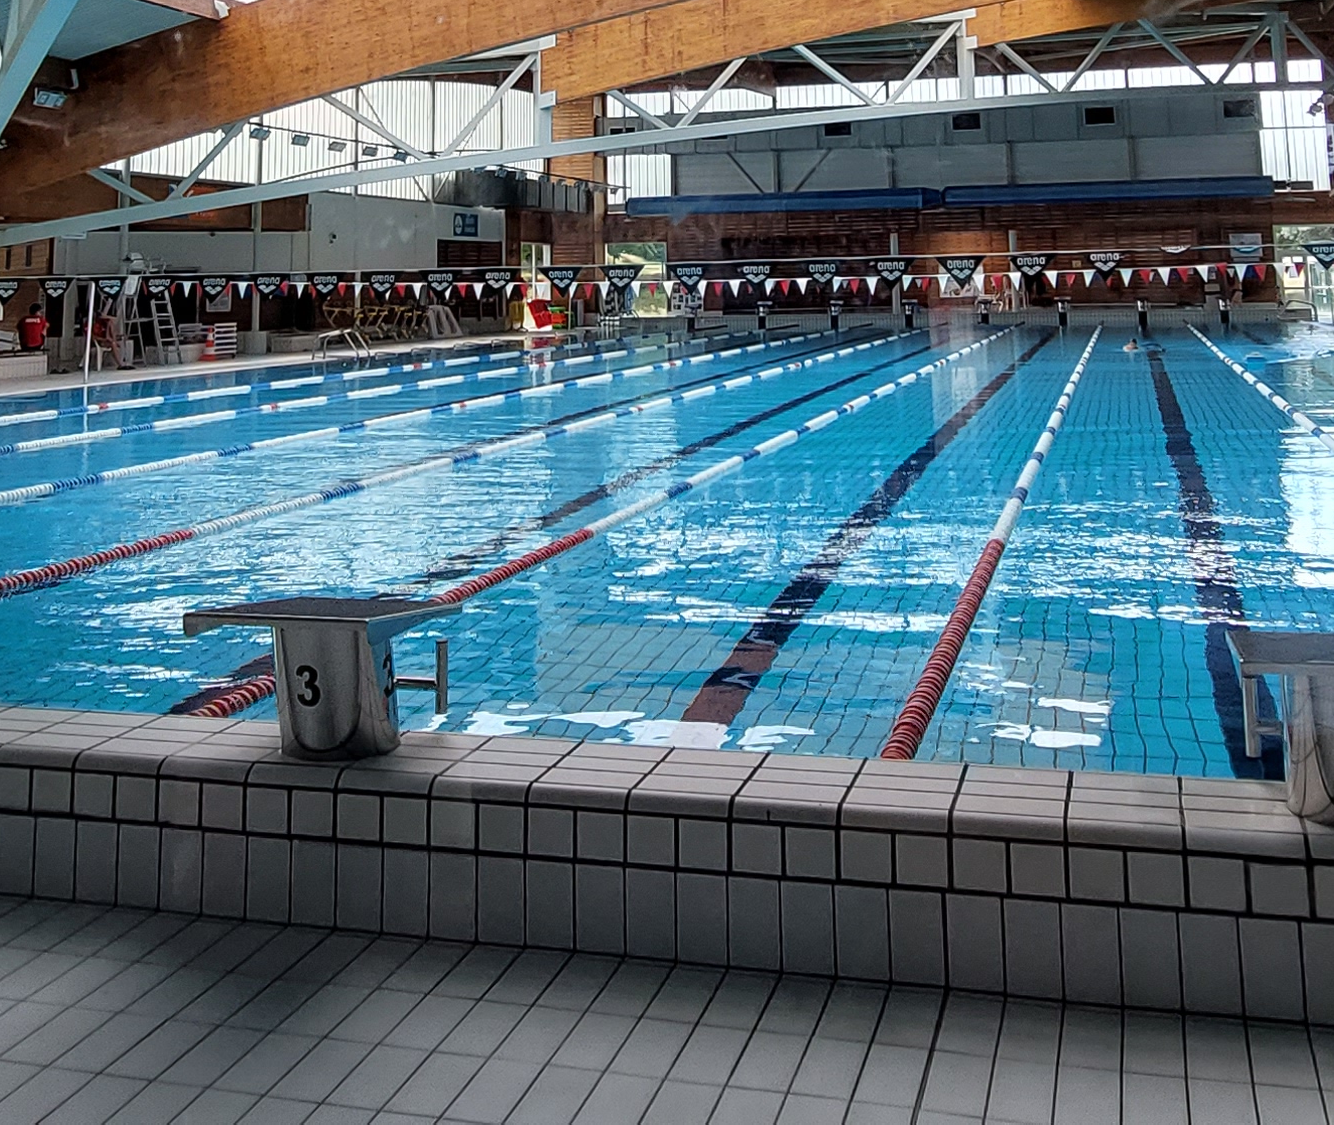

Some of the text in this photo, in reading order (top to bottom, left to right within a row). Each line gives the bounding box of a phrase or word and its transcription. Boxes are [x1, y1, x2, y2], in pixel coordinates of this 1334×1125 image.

[1017, 255, 1046, 266] arena
[1090, 252, 1120, 262] arena
[809, 263, 836, 273] arena
[877, 261, 906, 271] arena
[946, 259, 975, 269] arena
[548, 269, 573, 278] arena
[608, 269, 635, 278] arena
[676, 267, 703, 275] arena
[742, 265, 771, 274] arena
[257, 276, 280, 285] arena
[313, 276, 338, 284] arena
[371, 275, 395, 283] arena
[427, 274, 453, 282] arena
[485, 272, 511, 280] arena
[202, 277, 226, 286] arena
[295, 664, 321, 708] 3
